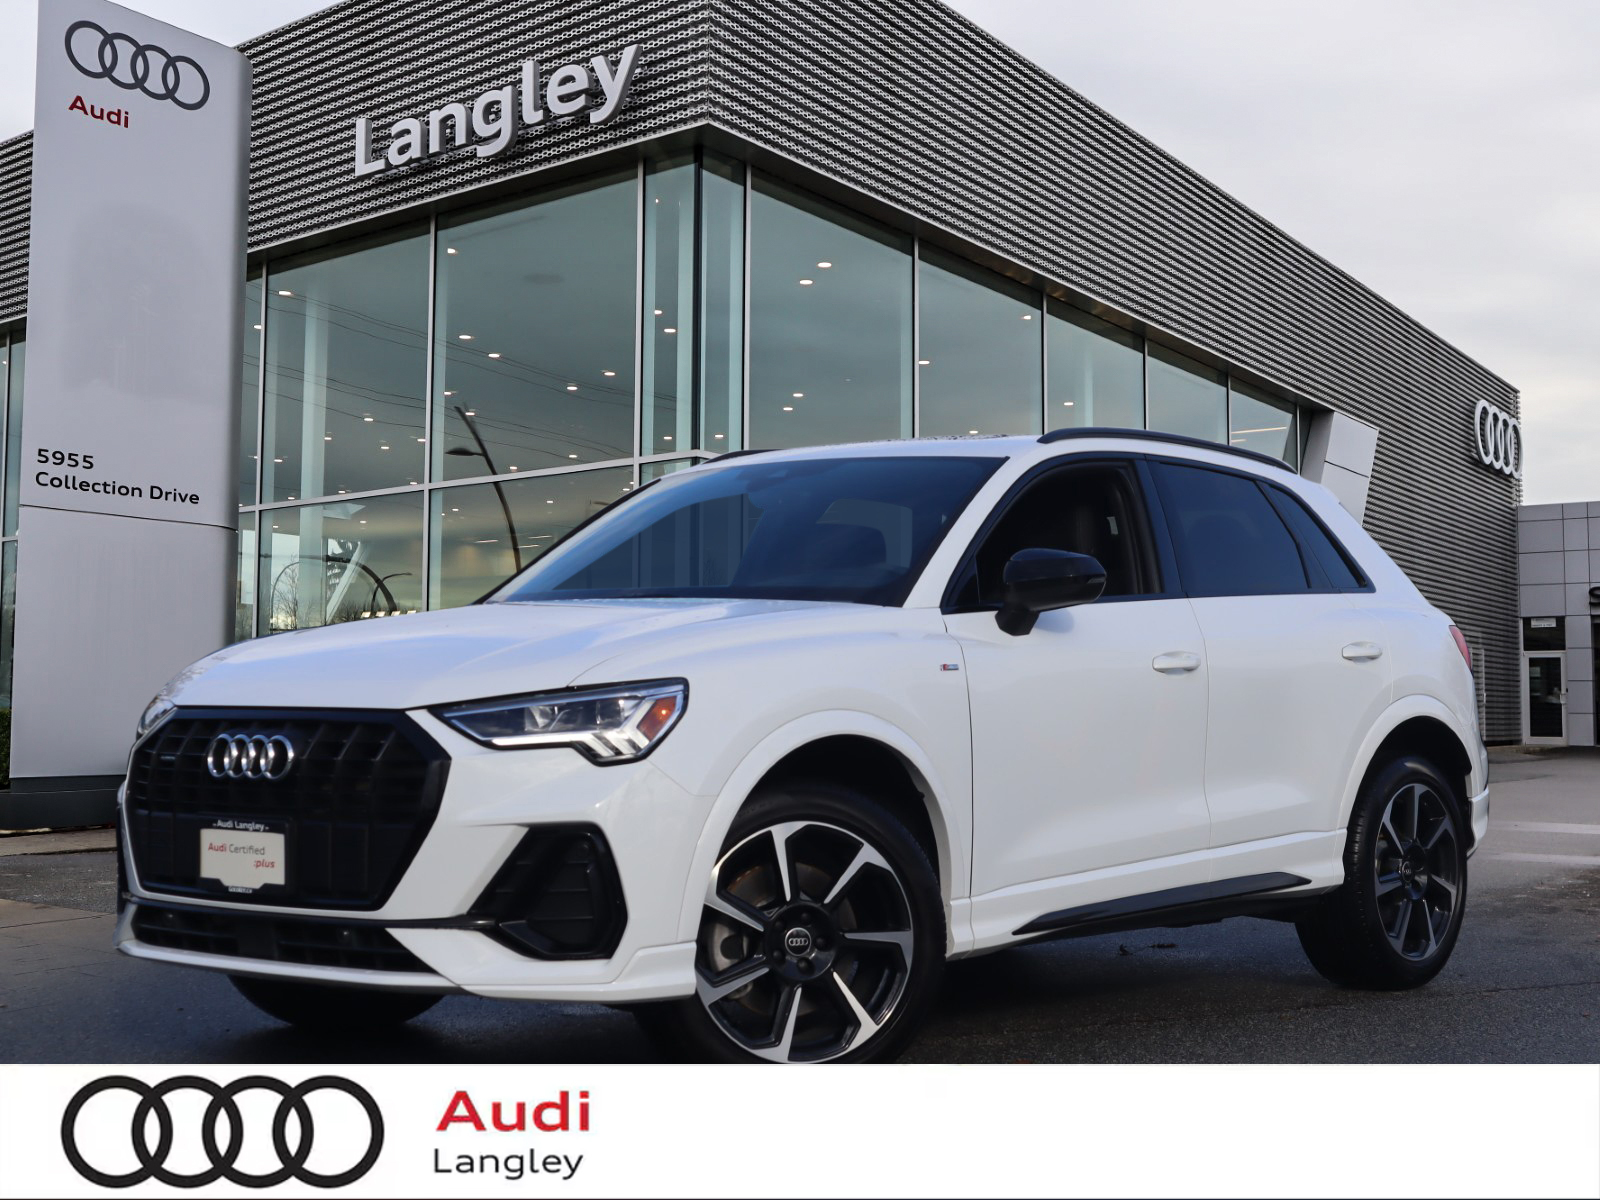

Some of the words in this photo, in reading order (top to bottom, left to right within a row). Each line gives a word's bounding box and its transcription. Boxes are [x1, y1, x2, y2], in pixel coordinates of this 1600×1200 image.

[68, 95, 130, 129] Audi
[354, 44, 642, 177] Langley
[37, 448, 94, 470] 5955
[35, 471, 143, 498] Collection
[149, 485, 200, 505] Drive
[217, 820, 233, 828] Audi
[234, 821, 265, 832] Langley
[208, 842, 227, 852] Audi
[229, 843, 266, 855] Certified
